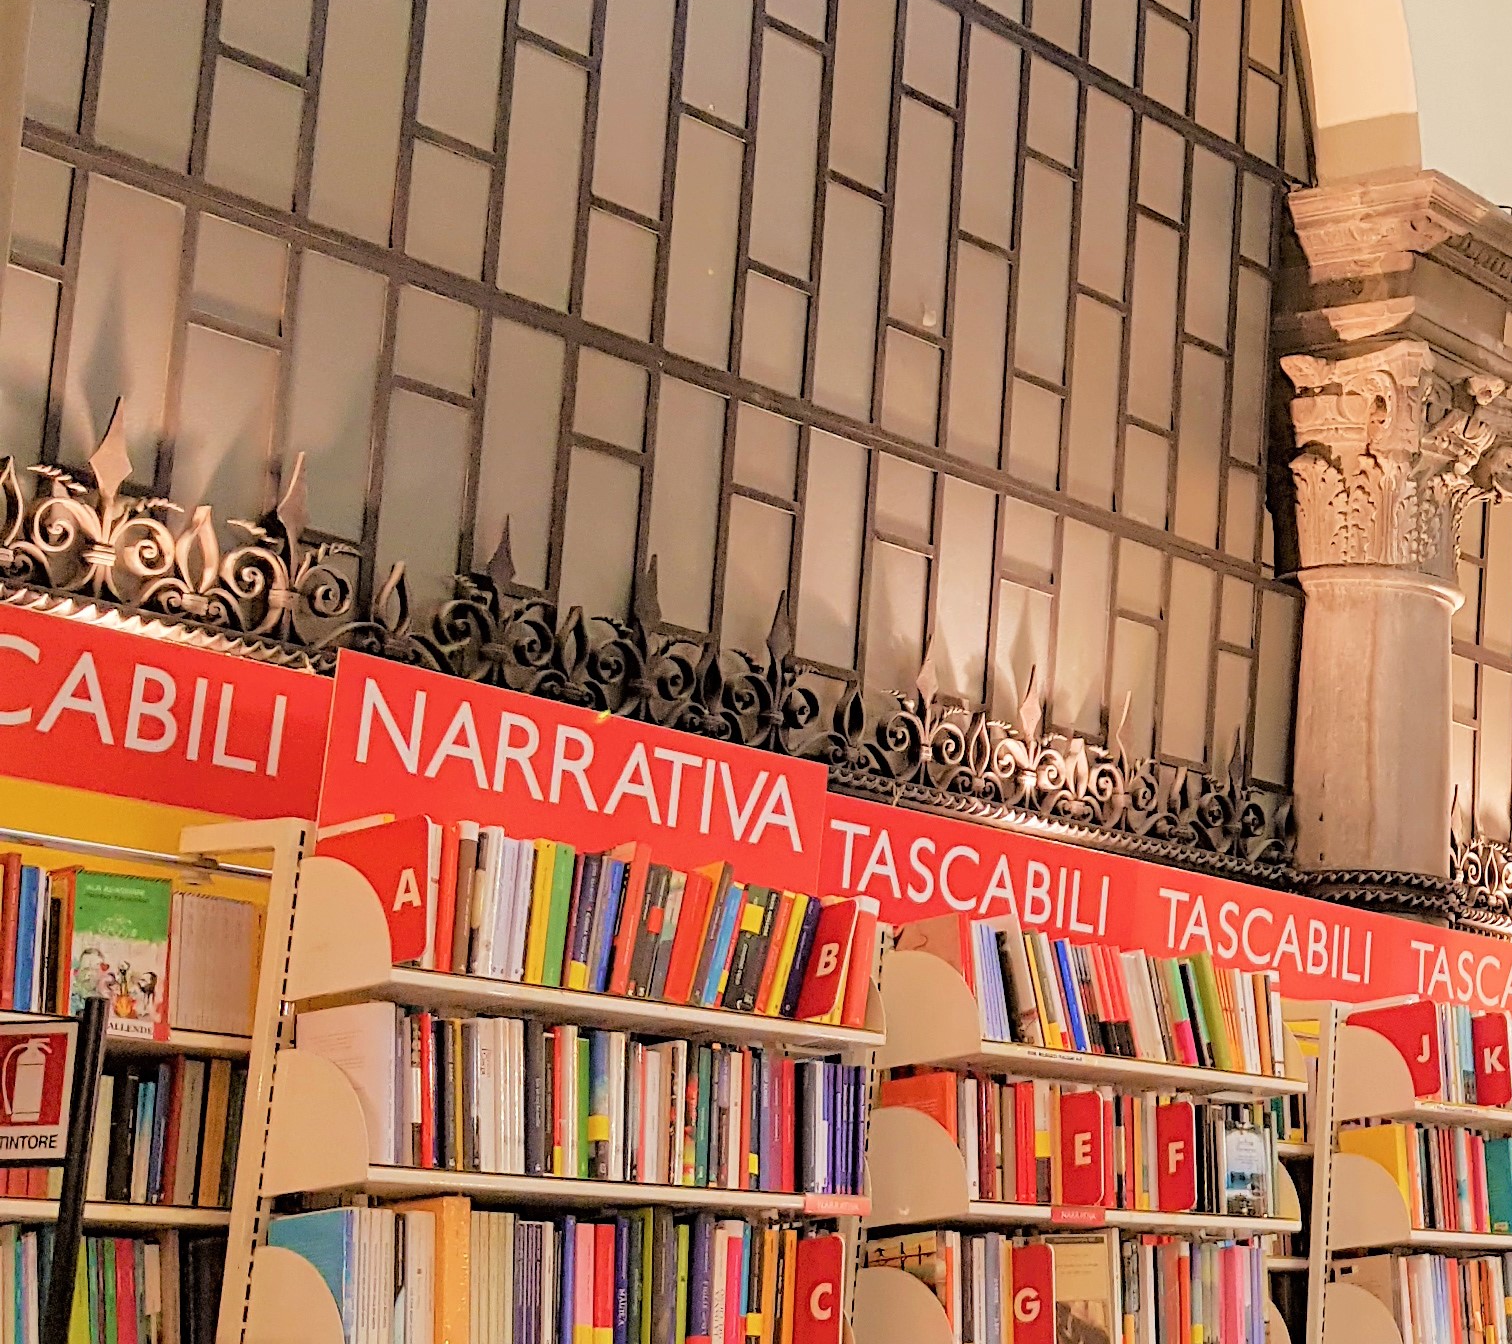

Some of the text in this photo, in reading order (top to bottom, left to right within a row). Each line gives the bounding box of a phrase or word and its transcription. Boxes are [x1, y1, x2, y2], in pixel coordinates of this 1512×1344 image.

[355, 678, 804, 855] NARRATIVA
[392, 867, 421, 911] A
[830, 818, 1111, 937] TASCABILI
[1158, 887, 1373, 985] TASCABILI
[816, 945, 838, 977] B
[1415, 1034, 1431, 1062] J
[1483, 1046, 1505, 1074] K
[1074, 1132, 1092, 1166] E
[1168, 1141, 1185, 1174] F
[810, 1282, 833, 1321] C
[1013, 1286, 1041, 1323] G
